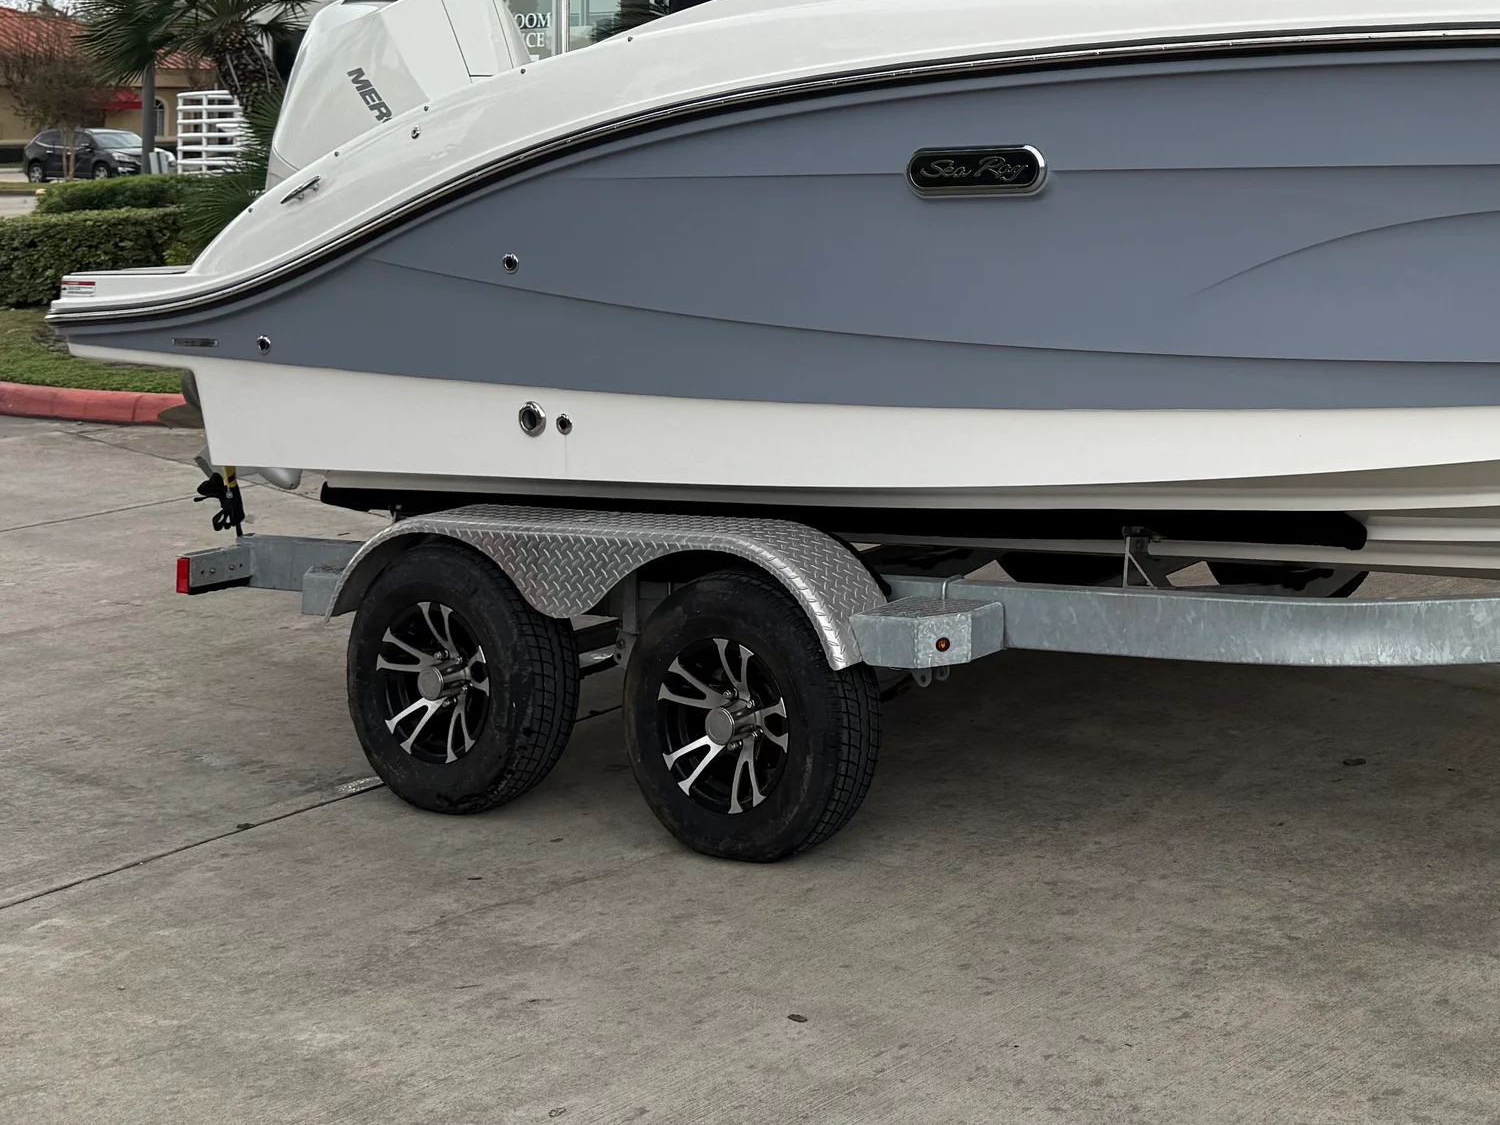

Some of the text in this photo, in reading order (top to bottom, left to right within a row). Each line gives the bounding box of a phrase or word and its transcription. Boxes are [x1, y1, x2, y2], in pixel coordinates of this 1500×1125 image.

[346, 67, 393, 124] MER
[920, 155, 1028, 182] Sea Ray
